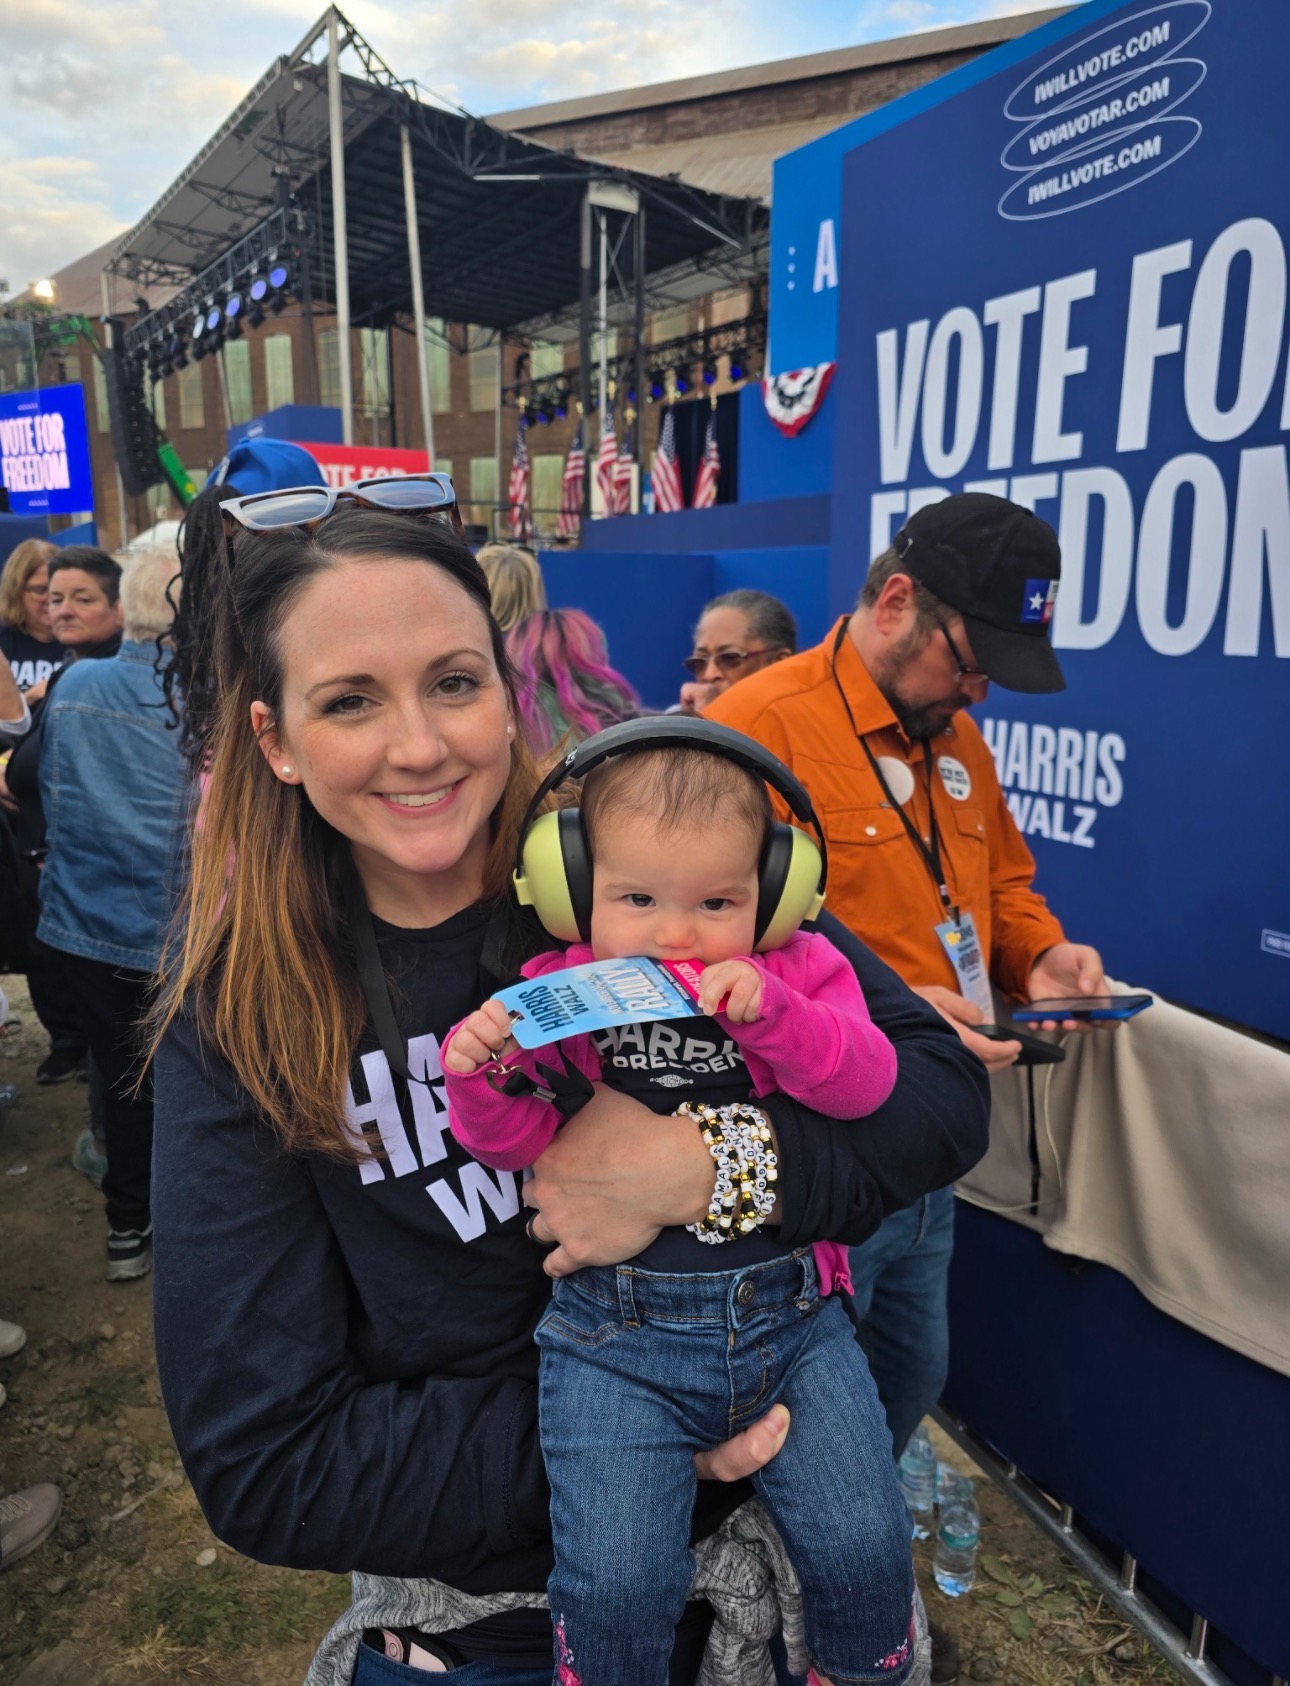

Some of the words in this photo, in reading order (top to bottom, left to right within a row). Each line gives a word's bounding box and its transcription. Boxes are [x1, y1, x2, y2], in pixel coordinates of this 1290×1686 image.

[1033, 20, 1171, 105] IWILLVOTE.COM
[1028, 76, 1171, 156] VOYAVOTAR.COM
[1027, 134, 1163, 206] IWILLVOTE.COM
[876, 267, 1097, 485] VOTE
[1116, 217, 1290, 453] FO
[0, 415, 36, 457] VOTE
[33, 412, 67, 453] FOR
[1, 450, 71, 493] FREEDOM
[982, 717, 1127, 808] HARRIS
[1002, 791, 1098, 849] WALZ
[518, 985, 575, 1033] HARRIS
[553, 984, 590, 1016] WALZ
[598, 967, 671, 1012] RALLY
[341, 1025, 454, 1186] HA
[425, 1161, 536, 1244] W
